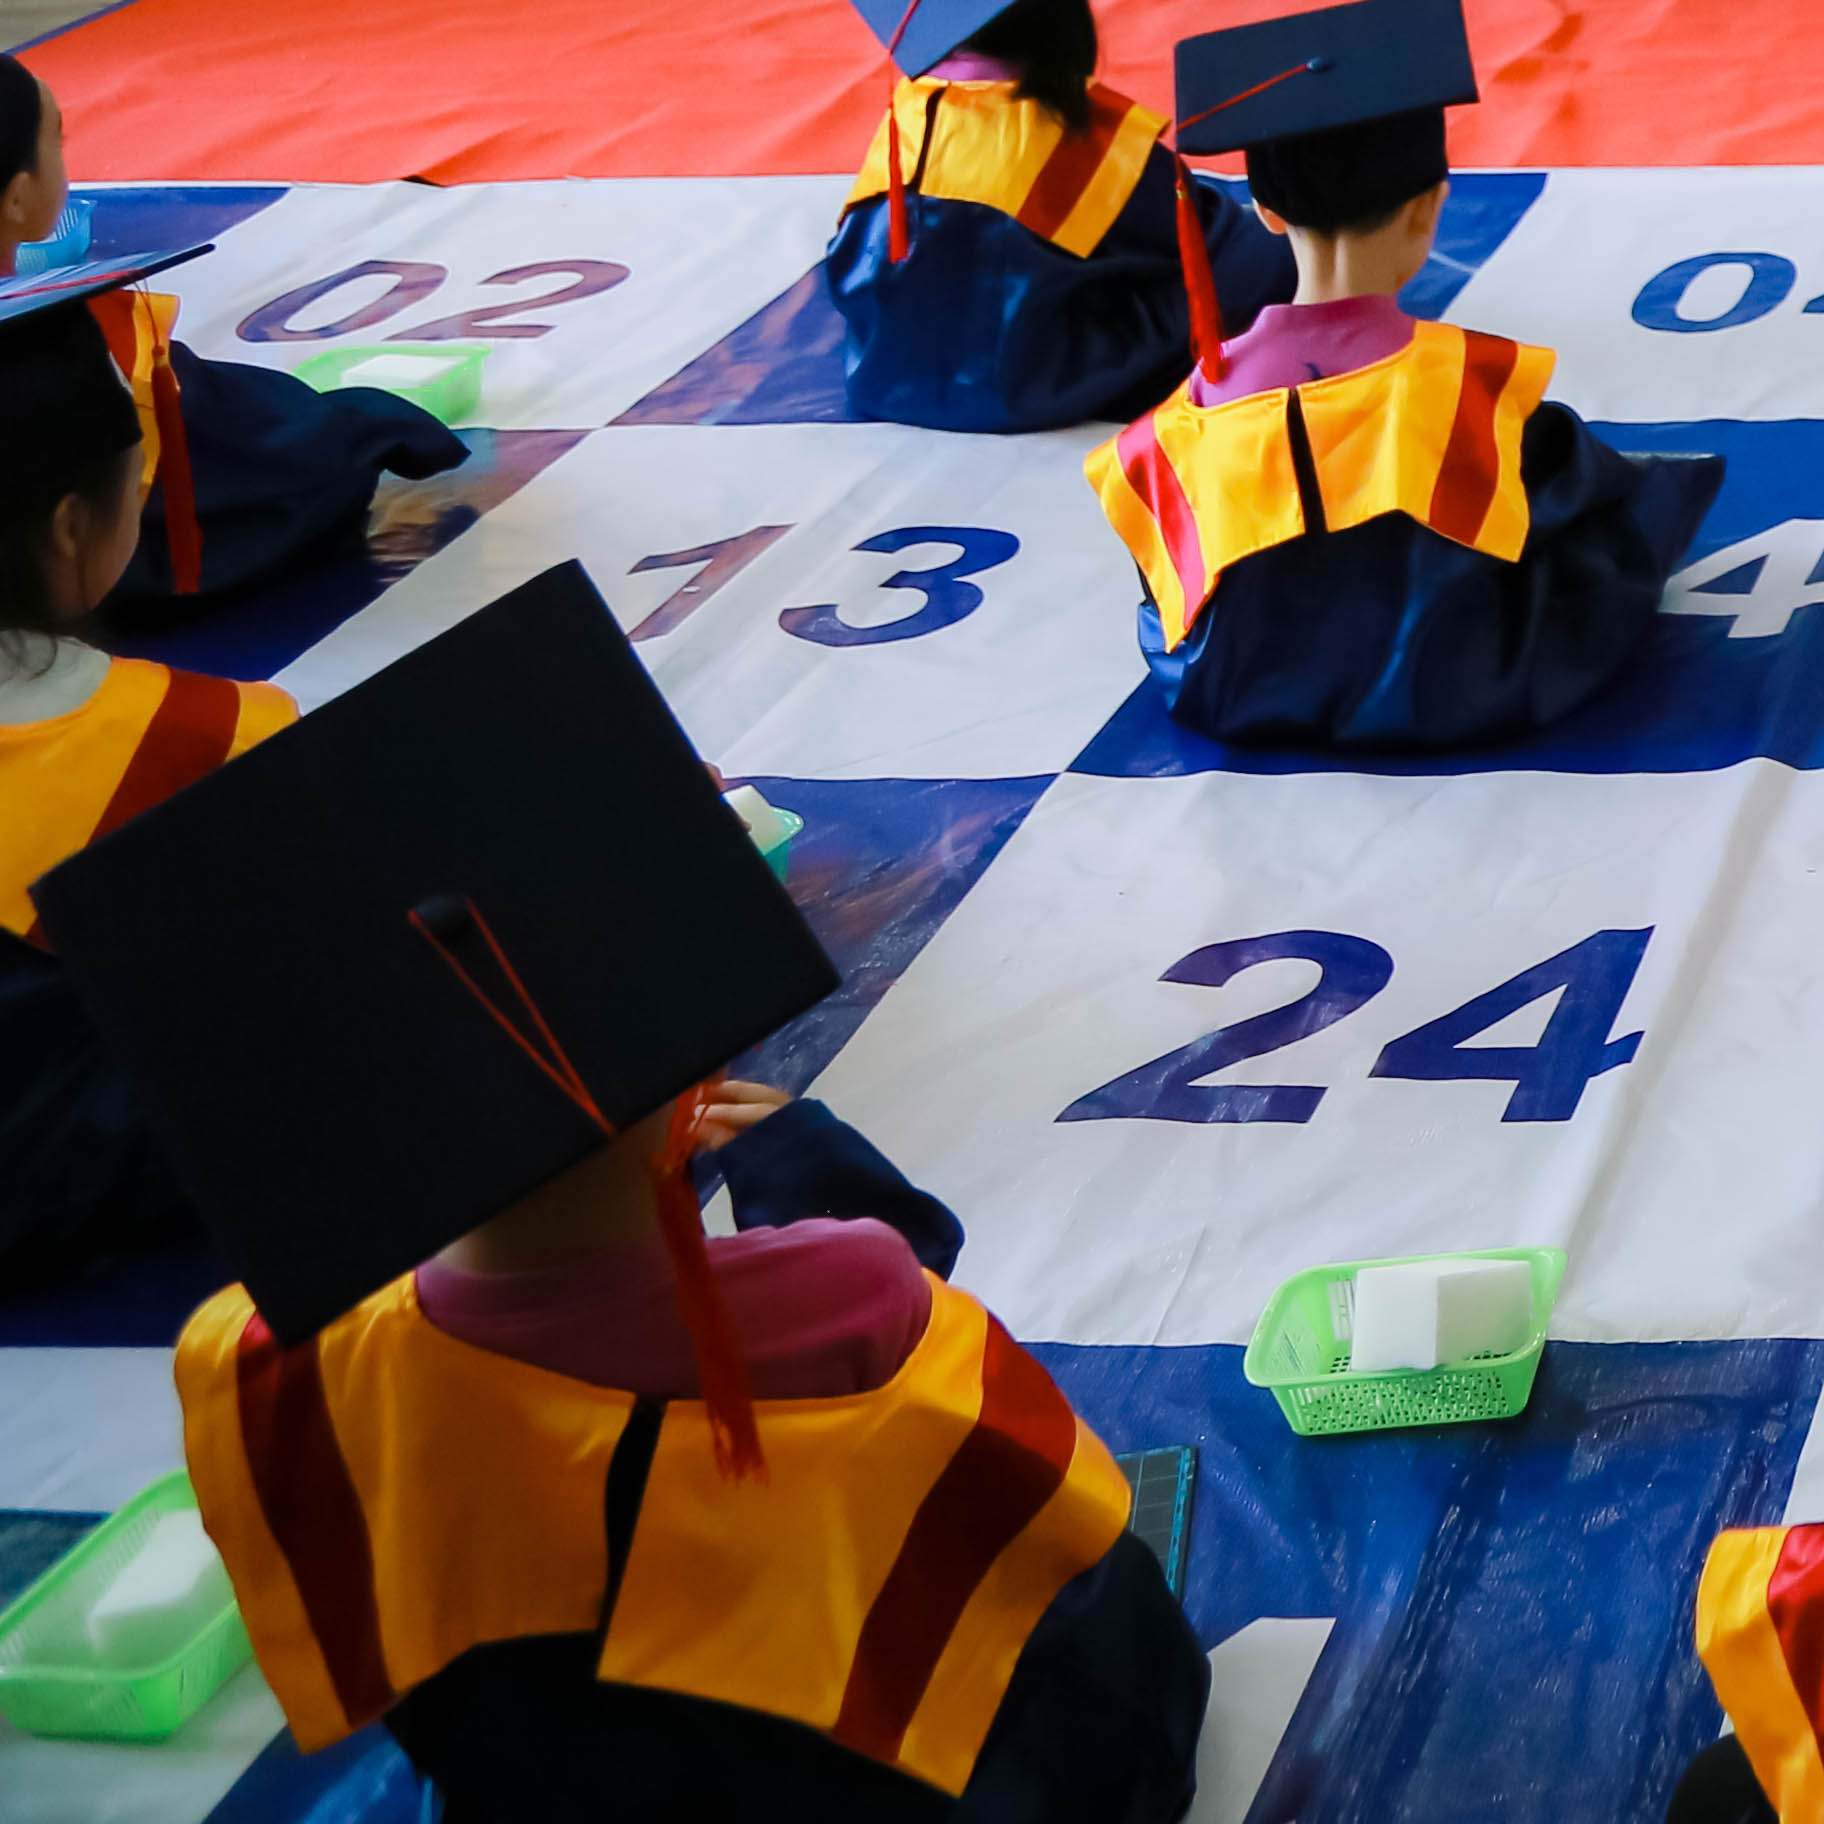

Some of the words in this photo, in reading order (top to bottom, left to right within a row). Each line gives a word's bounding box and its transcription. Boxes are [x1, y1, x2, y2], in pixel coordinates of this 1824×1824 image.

[232, 259, 633, 343] 02
[626, 522, 1021, 648] 13
[1053, 924, 1656, 1125] 24
